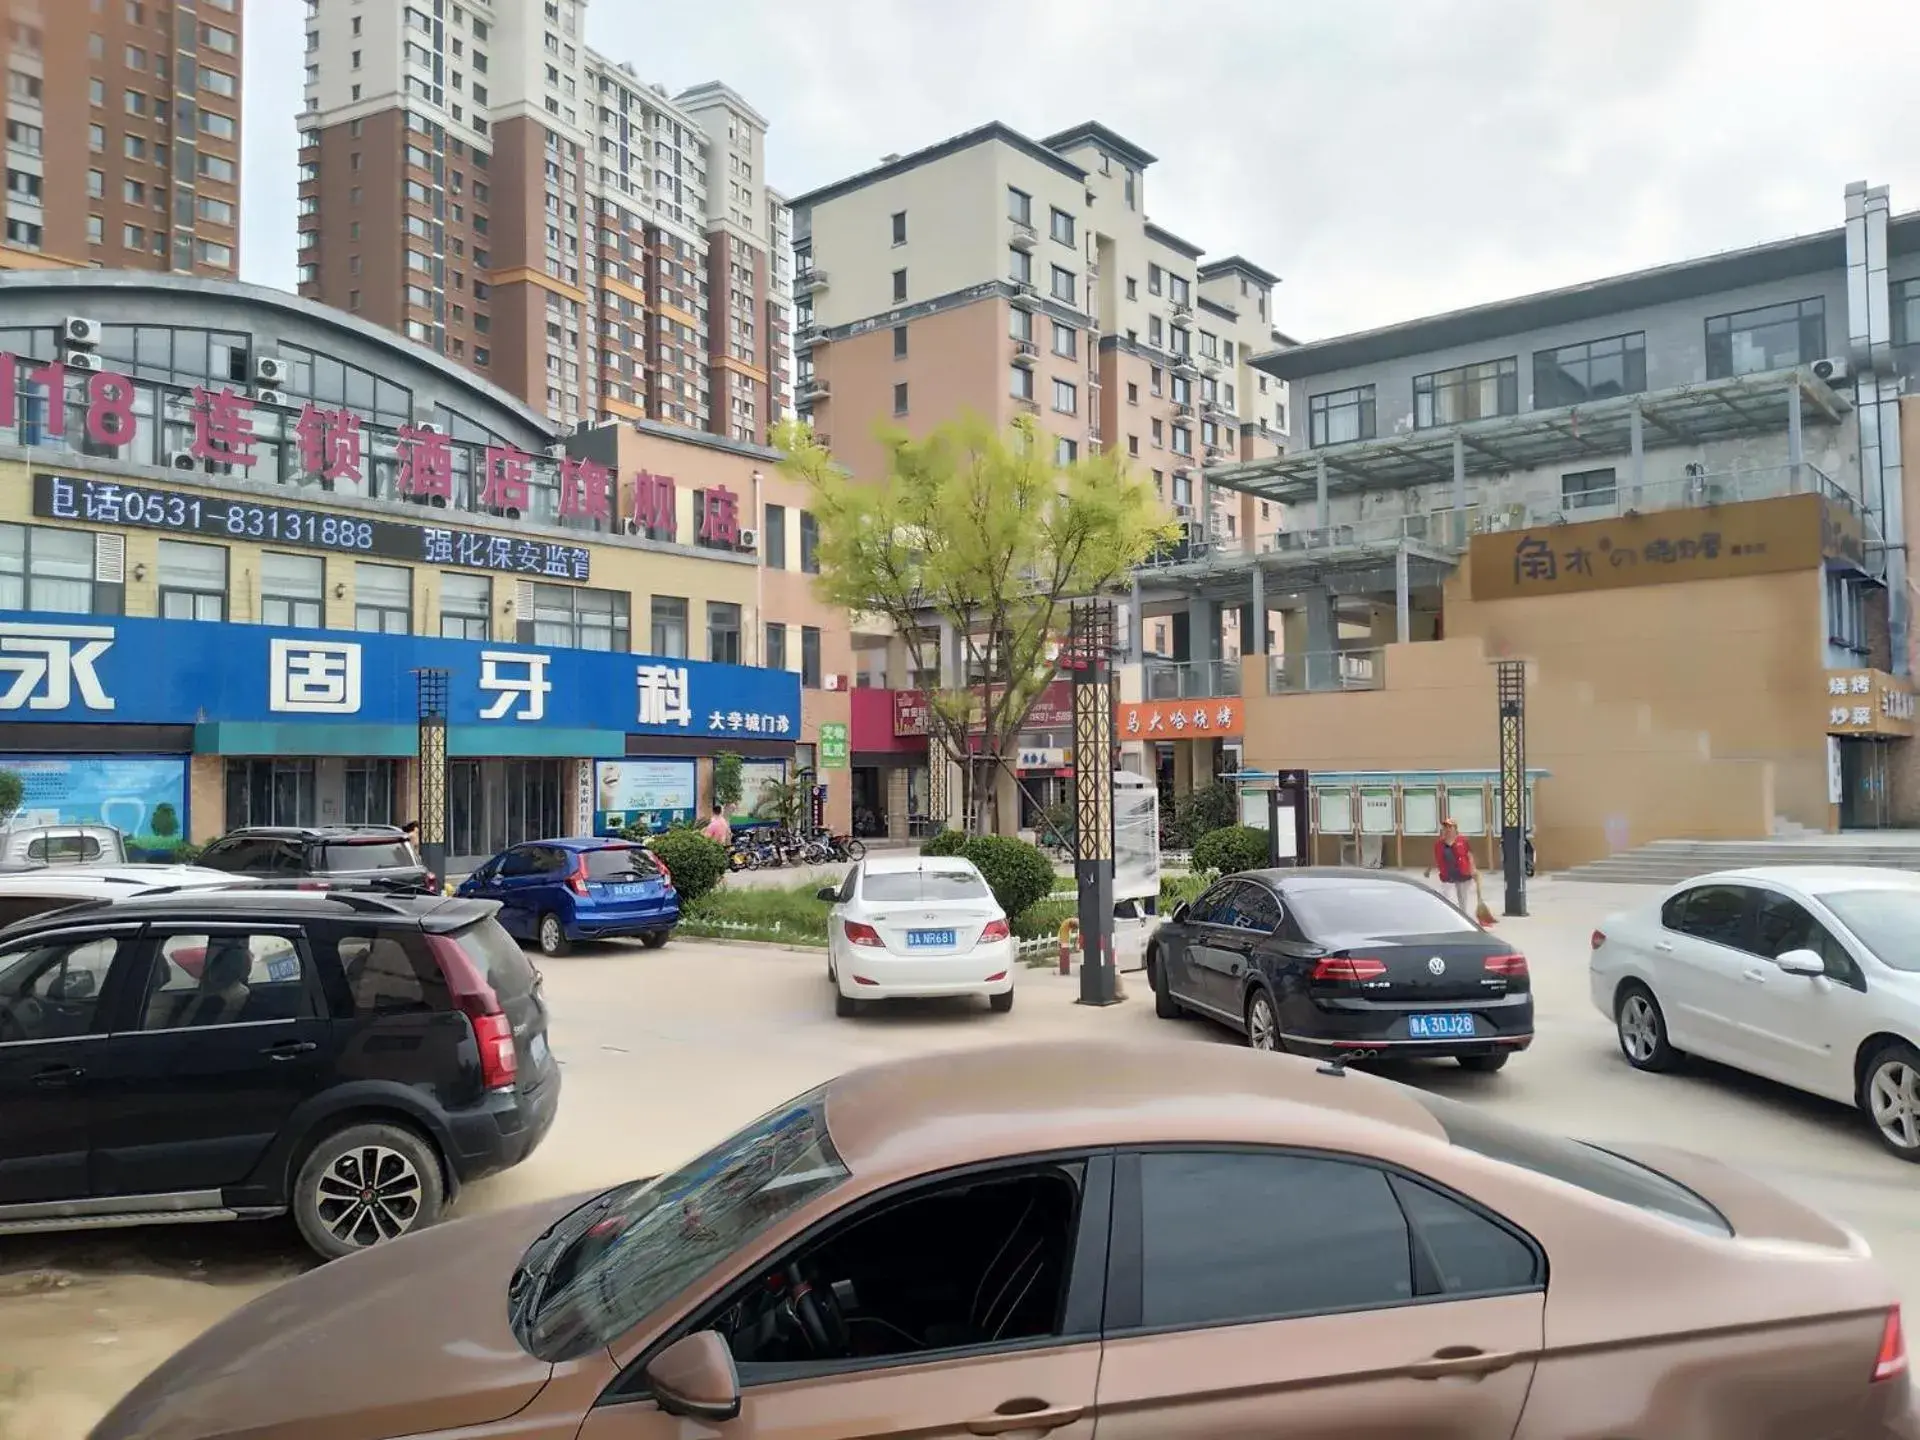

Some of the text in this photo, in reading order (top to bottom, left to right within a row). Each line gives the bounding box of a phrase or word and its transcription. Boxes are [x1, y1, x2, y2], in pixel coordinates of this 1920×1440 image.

[708, 710, 790, 733] 大学城门诊
[1127, 704, 1233, 733] 马大哈烧烤
